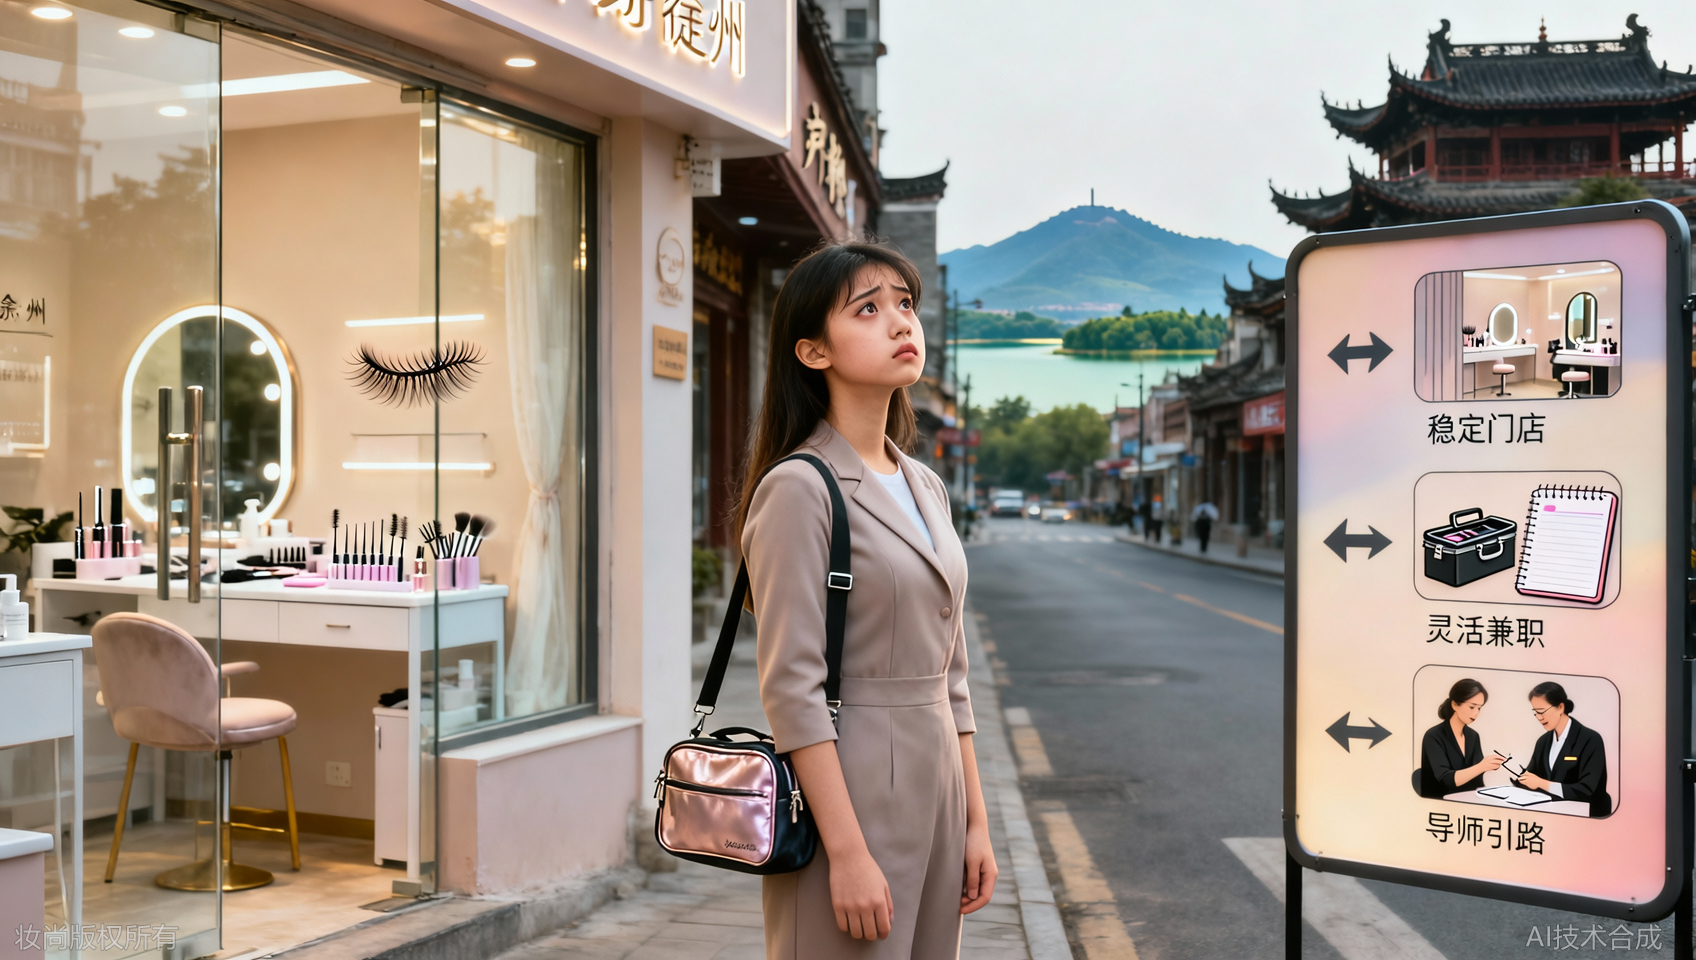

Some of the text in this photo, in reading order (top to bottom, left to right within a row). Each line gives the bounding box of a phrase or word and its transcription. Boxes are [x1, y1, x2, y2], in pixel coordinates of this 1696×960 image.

[1427, 412, 1546, 445] 稳定门店
[1426, 614, 1545, 648] 灵活兼职
[1425, 811, 1546, 855] 导师引路
